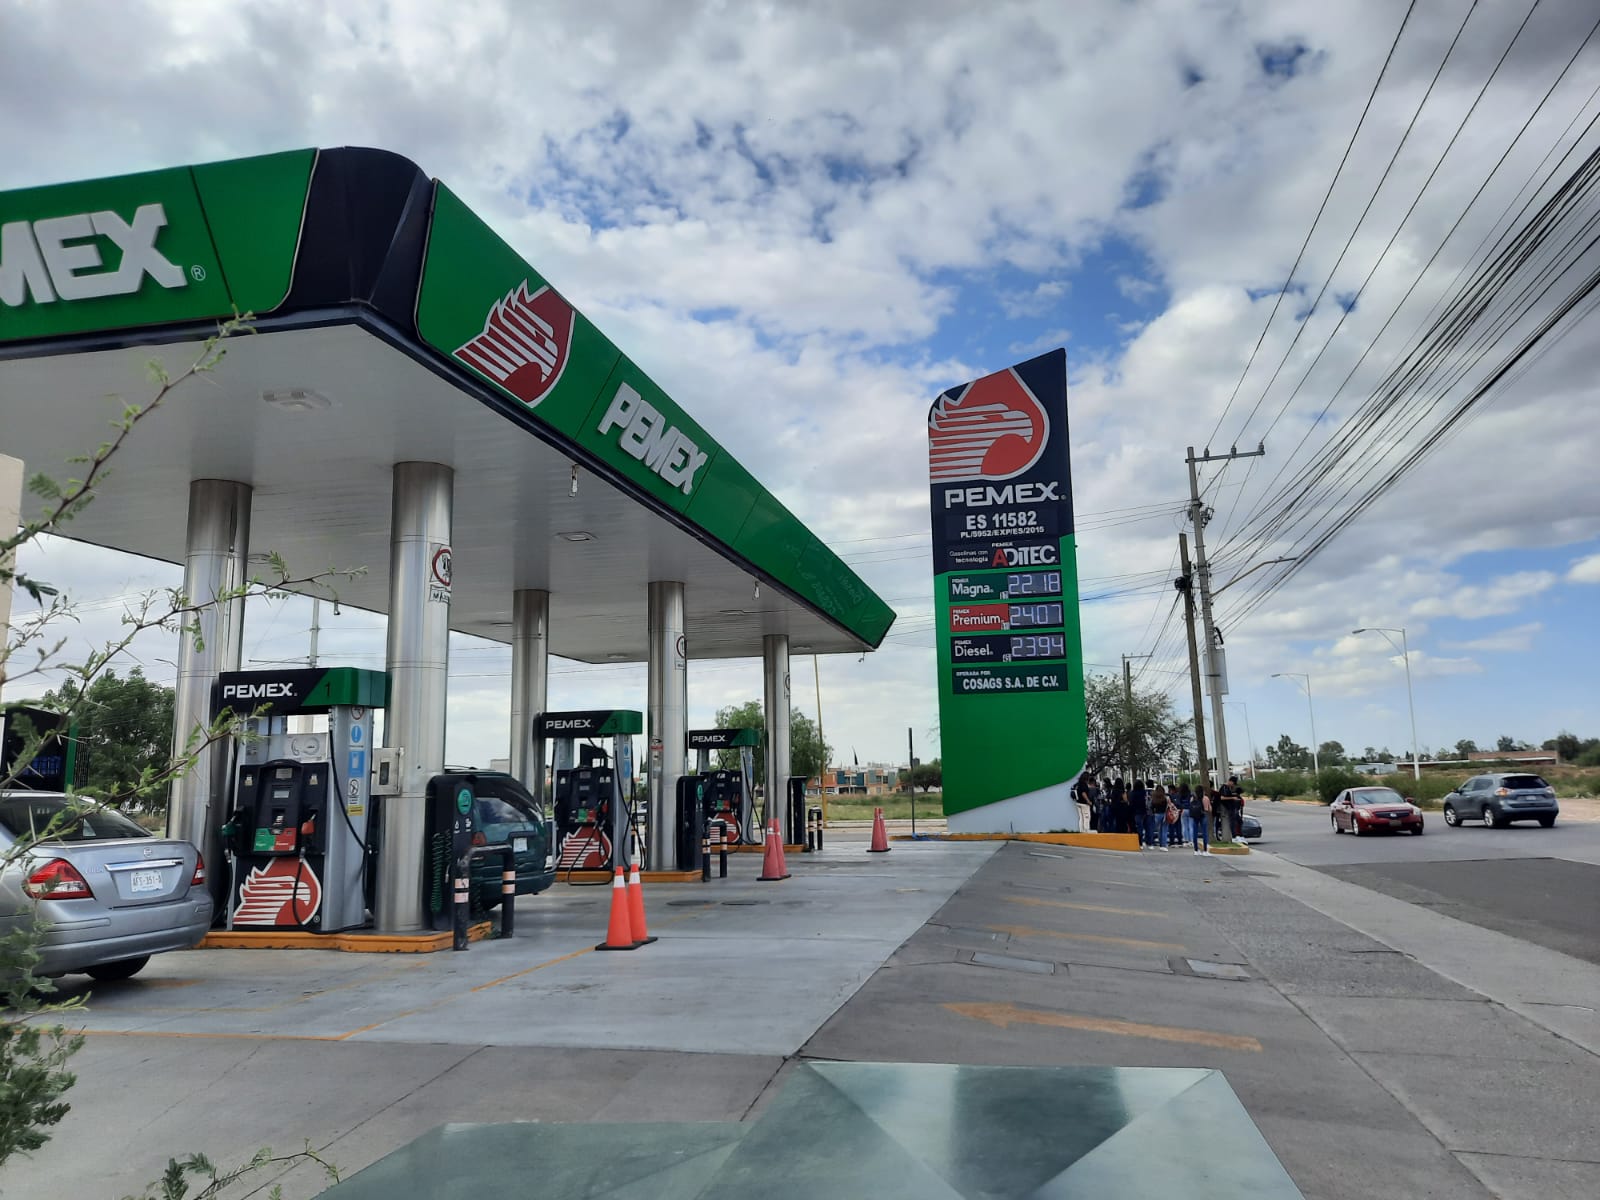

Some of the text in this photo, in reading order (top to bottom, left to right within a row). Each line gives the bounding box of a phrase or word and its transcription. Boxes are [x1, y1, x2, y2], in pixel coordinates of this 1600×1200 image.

[597, 381, 708, 495] PEMEX
[945, 482, 1059, 508] PEMEX
[966, 511, 1037, 530] ES 11582
[953, 613, 1001, 625] Premium
[955, 644, 990, 656] Diesel
[325, 682, 331, 697] 1
[963, 675, 1059, 690] COSAGS S.A. DE C.V.
[223, 683, 294, 699] PEMEX
[545, 719, 592, 730] PEMEX
[611, 718, 618, 729] 3
[691, 734, 726, 743] PEMEX
